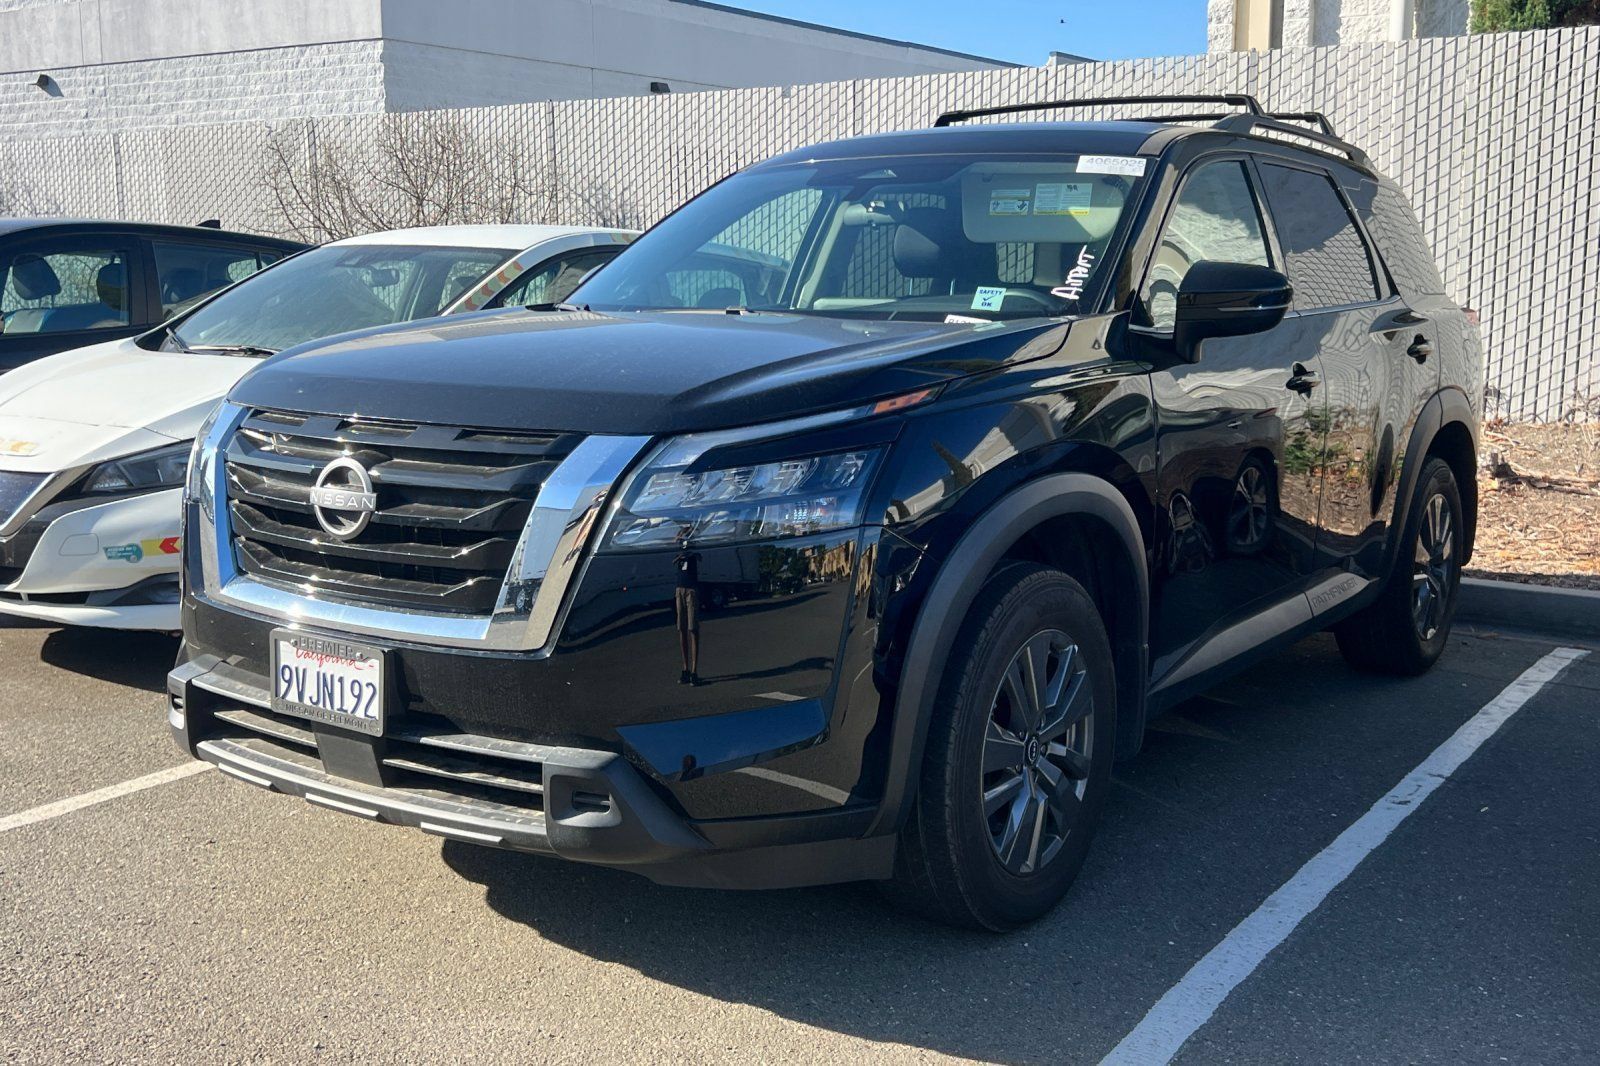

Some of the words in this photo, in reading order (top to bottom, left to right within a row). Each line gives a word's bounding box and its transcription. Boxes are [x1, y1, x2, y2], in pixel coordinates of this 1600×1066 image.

[310, 490, 374, 509] NISSAN
[300, 637, 353, 657] PREMIER
[280, 664, 378, 719] 9VJN192
